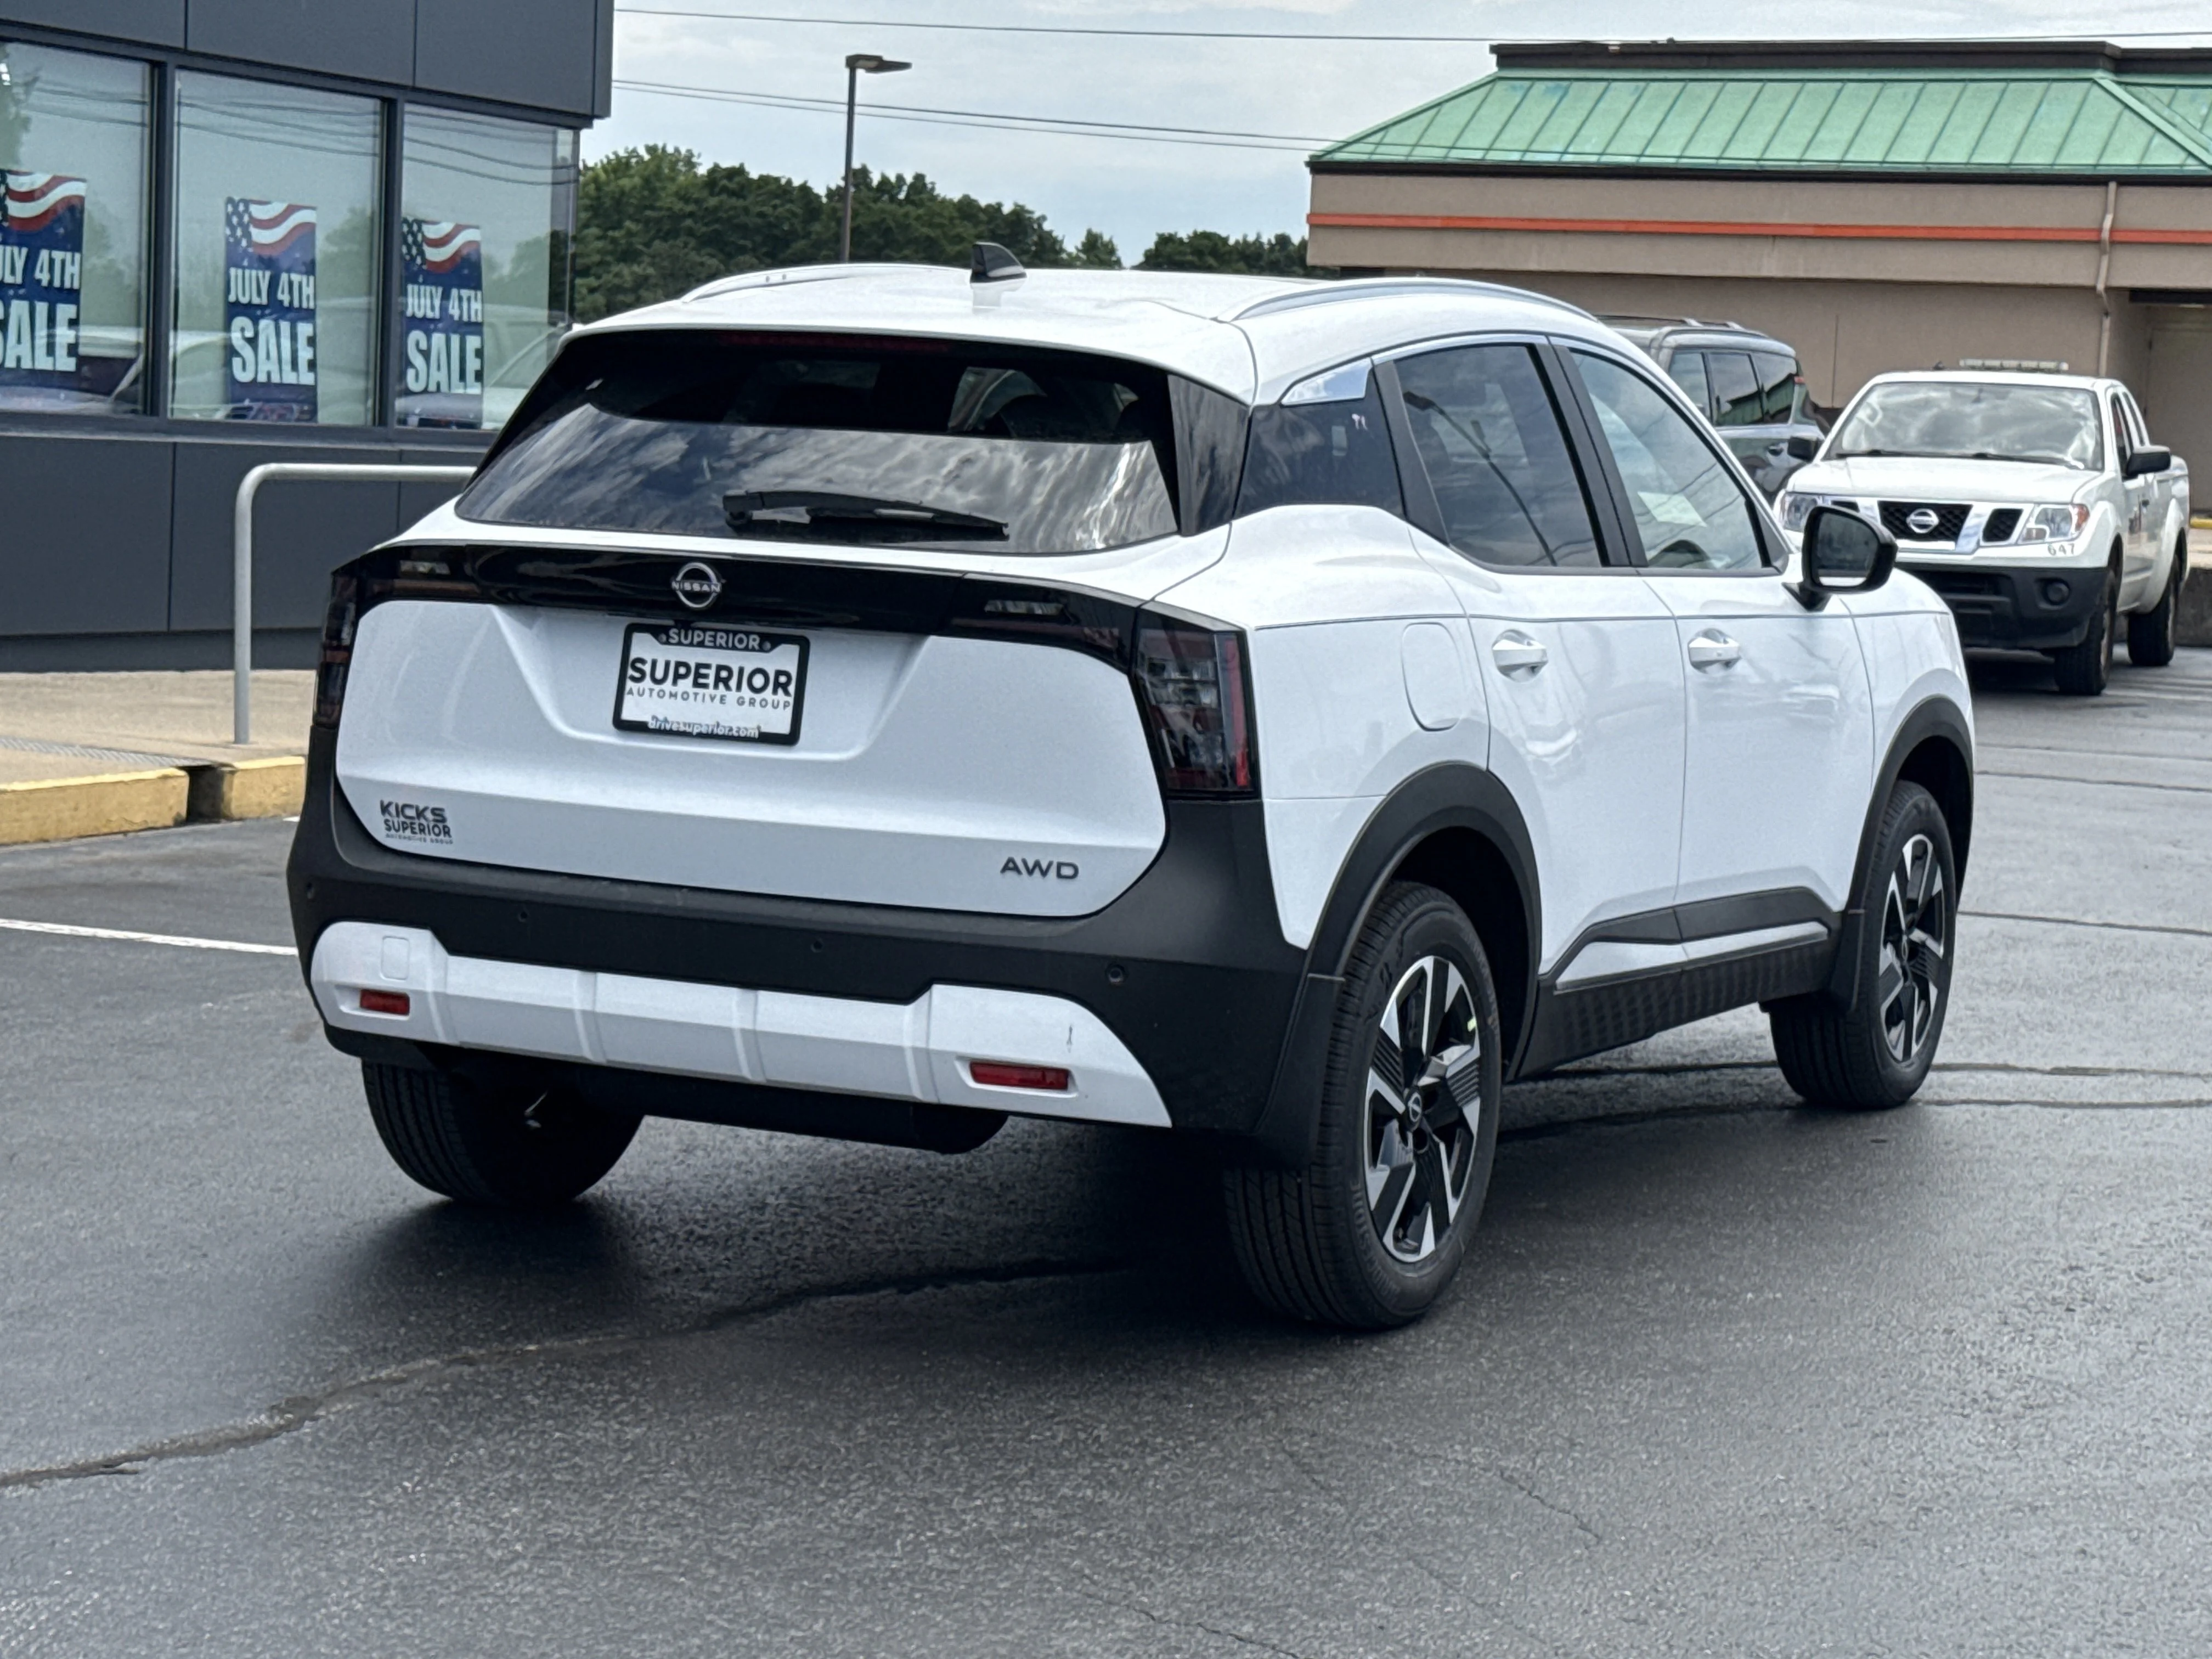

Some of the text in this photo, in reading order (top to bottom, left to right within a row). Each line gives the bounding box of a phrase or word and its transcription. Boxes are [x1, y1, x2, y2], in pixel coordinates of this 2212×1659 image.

[34, 249, 81, 290] 4TH
[228, 267, 315, 309] JULY 4TH
[407, 284, 482, 323] JULY 4TH
[0, 299, 77, 371] ALE
[231, 316, 315, 385] SALE
[407, 329, 482, 394] SALE
[2047, 542, 2075, 556] 647
[672, 580, 720, 593] NISSAN
[669, 629, 760, 650] SUPERIOR
[628, 657, 792, 697] SUPERIOR
[627, 687, 791, 711] AUTOMOTIVE GROUP
[647, 715, 761, 738] drivesuperior.com
[380, 799, 448, 823] KICKS
[383, 818, 452, 838] SUPERIOR
[1000, 856, 1079, 879] AWD
